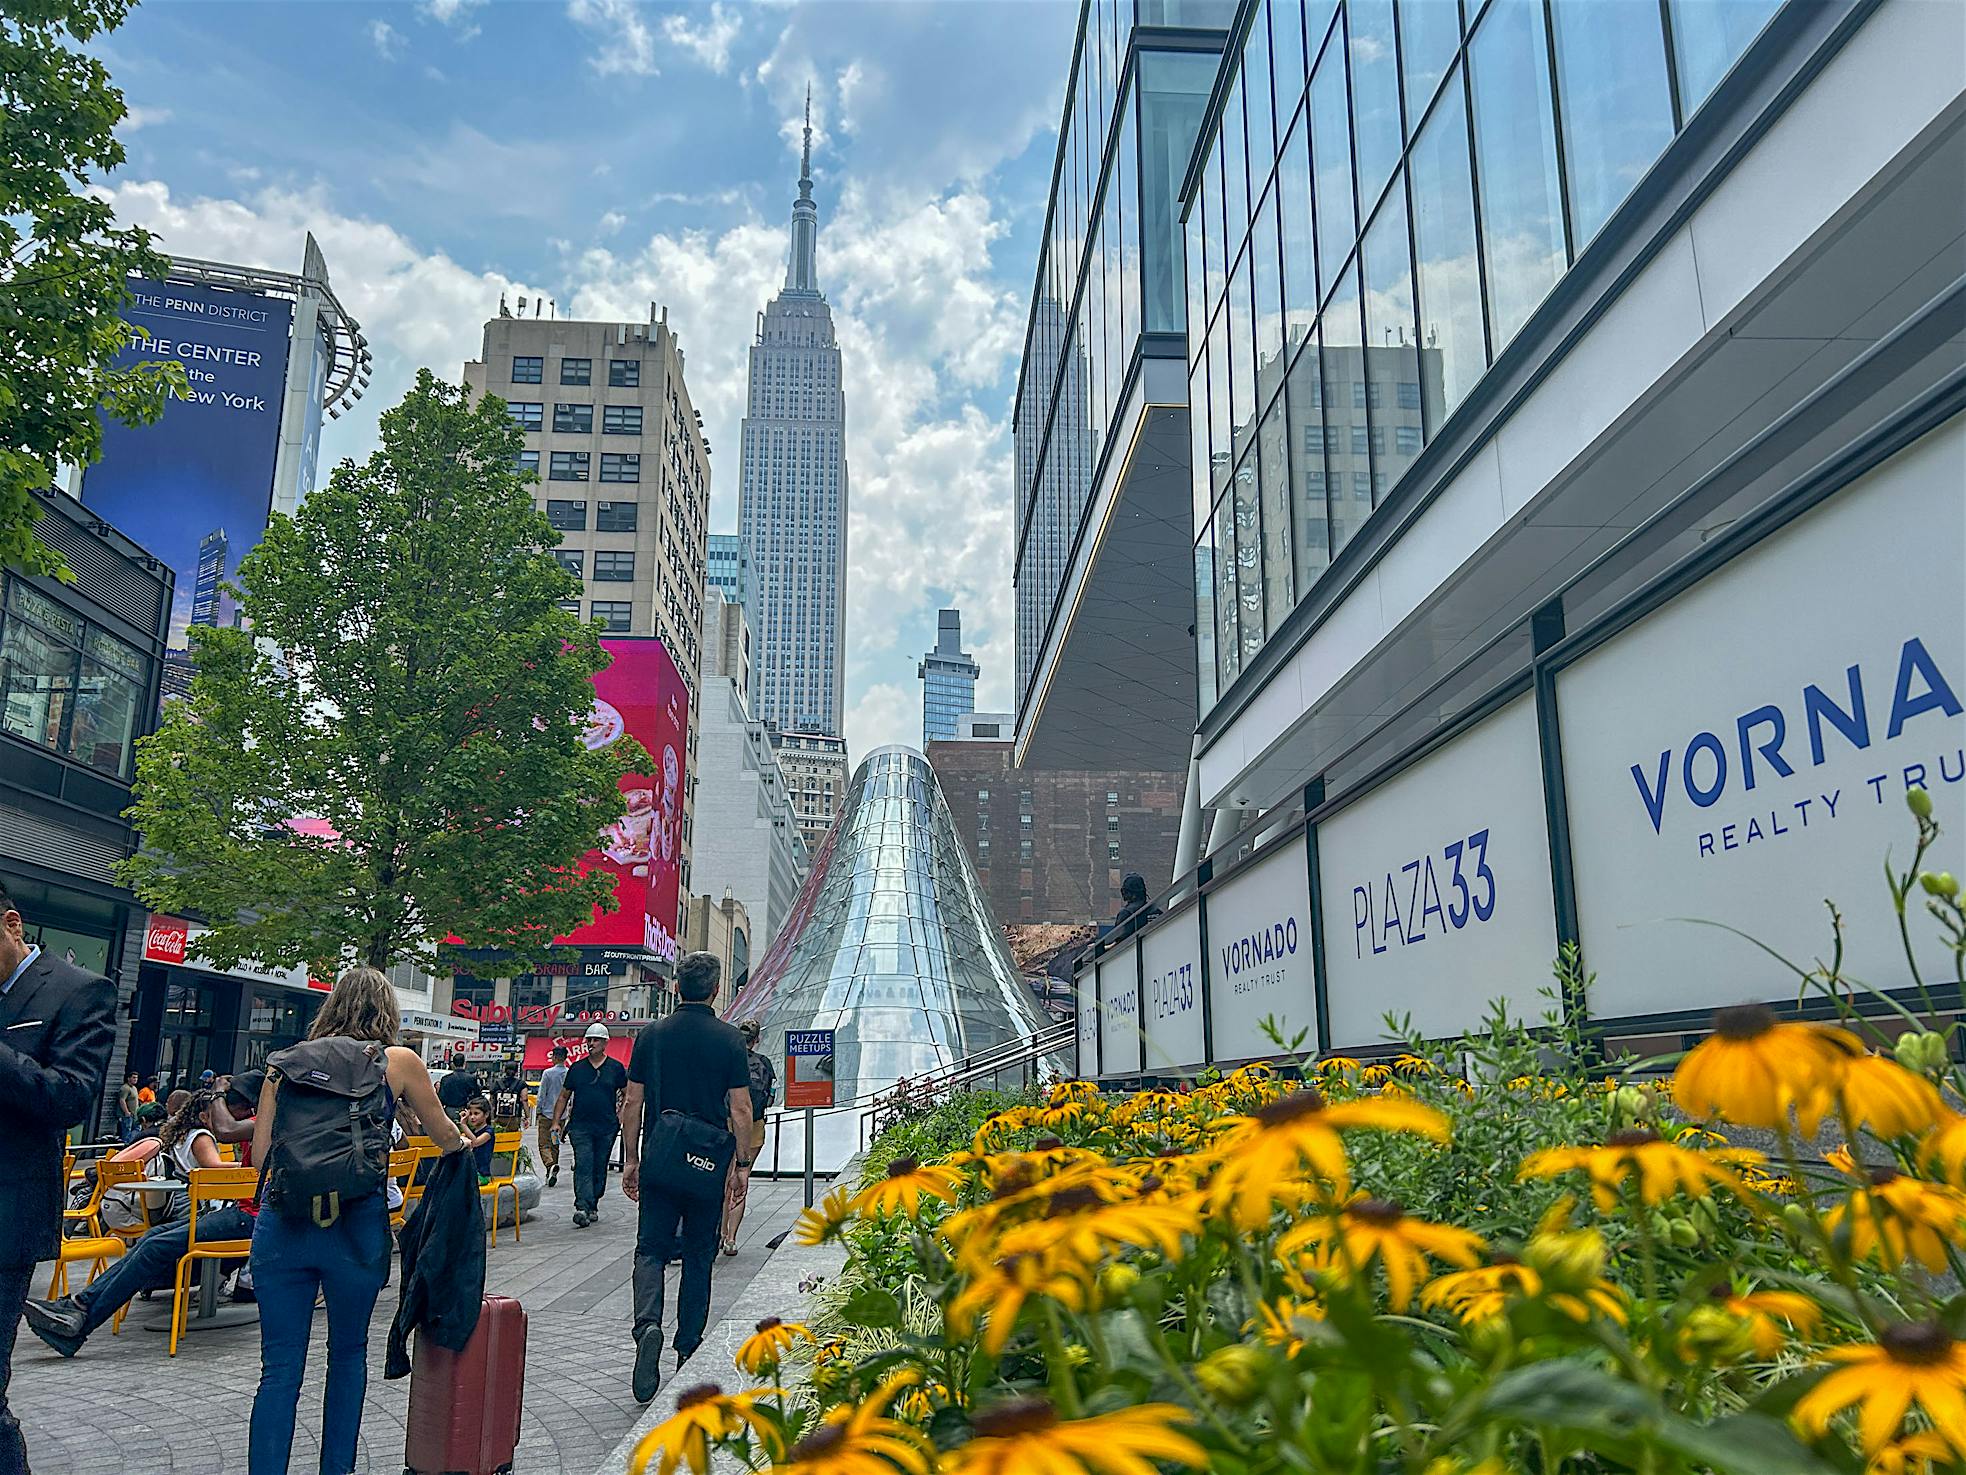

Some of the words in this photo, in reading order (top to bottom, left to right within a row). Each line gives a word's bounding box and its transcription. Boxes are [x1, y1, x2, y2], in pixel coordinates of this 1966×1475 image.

[134, 293, 161, 308] THE
[164, 298, 205, 314] PENN
[208, 304, 269, 323] DISTRICT
[129, 335, 172, 355] THE
[176, 342, 262, 367] CENTER
[188, 368, 215, 383] the
[220, 391, 265, 412] York
[18, 593, 42, 619] PIZZA
[51, 612, 74, 636] PASTA
[1630, 637, 1964, 836] VORNA
[1698, 789, 1840, 858] REALTY
[1353, 828, 1496, 960] PLAZA33
[1222, 916, 1297, 982] VORNADO
[585, 964, 611, 976] BAR
[1234, 977, 1259, 996] REALTY
[1260, 969, 1286, 988] TRUST
[1105, 989, 1136, 1023] VORNADO
[1153, 963, 1193, 1021] PLAZA33
[413, 1016, 424, 1025] PENN
[424, 1018, 439, 1028] STATION
[451, 999, 561, 1028] Subway
[789, 1033, 831, 1044] PUZZLE
[789, 1043, 832, 1053] MEETUPS
